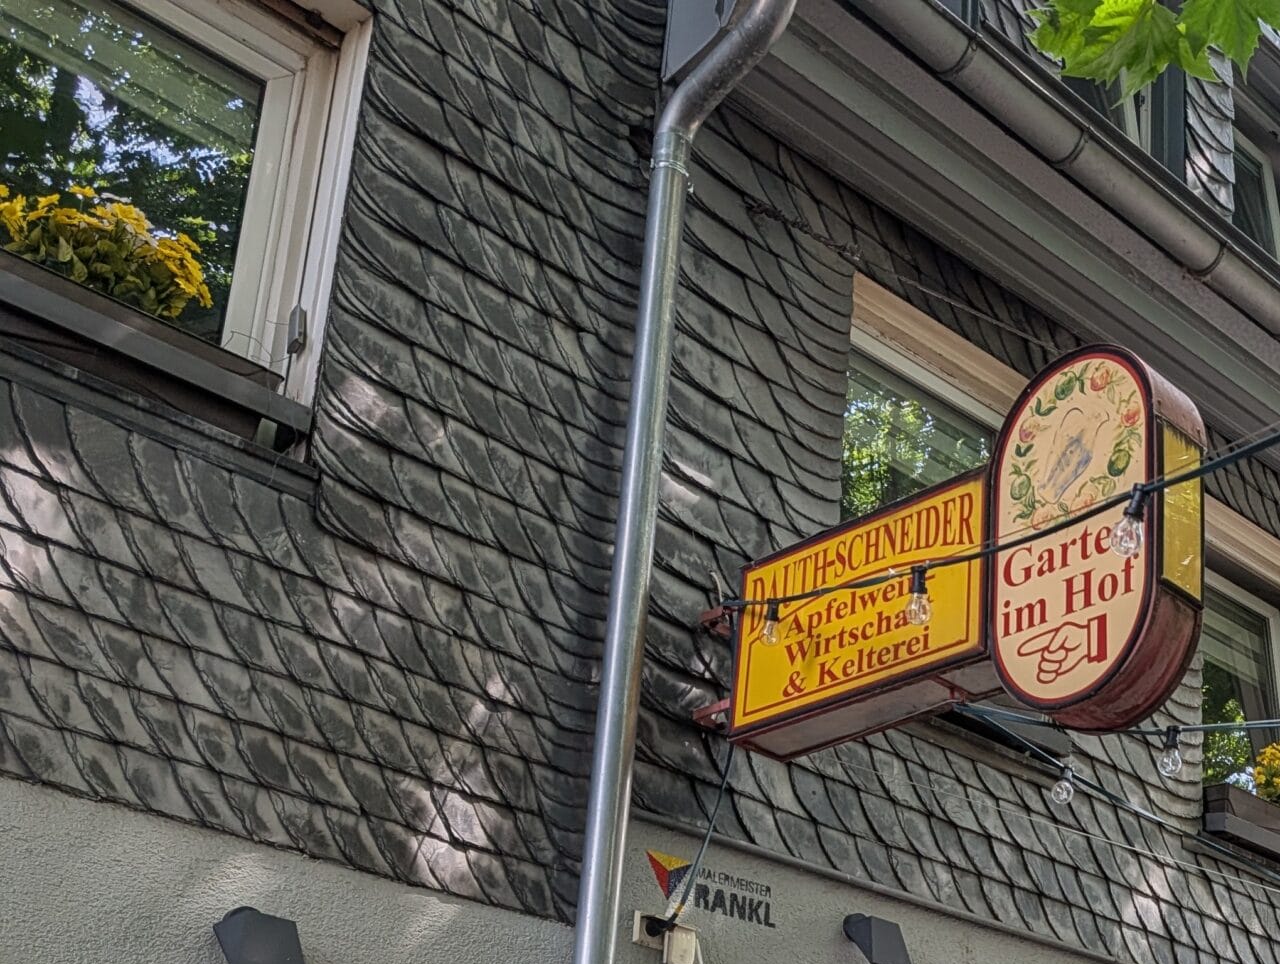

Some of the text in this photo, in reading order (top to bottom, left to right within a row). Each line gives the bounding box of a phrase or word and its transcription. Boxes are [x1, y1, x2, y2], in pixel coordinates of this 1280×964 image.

[1002, 520, 1136, 588] Garte
[784, 573, 936, 639] Apfelwei-
[1001, 553, 1139, 639] im Hof
[782, 626, 930, 699] & Kelterei
[784, 596, 934, 667] Wirtscha
[694, 884, 776, 928] RANKL
[697, 867, 771, 898] MALERMEISTER
